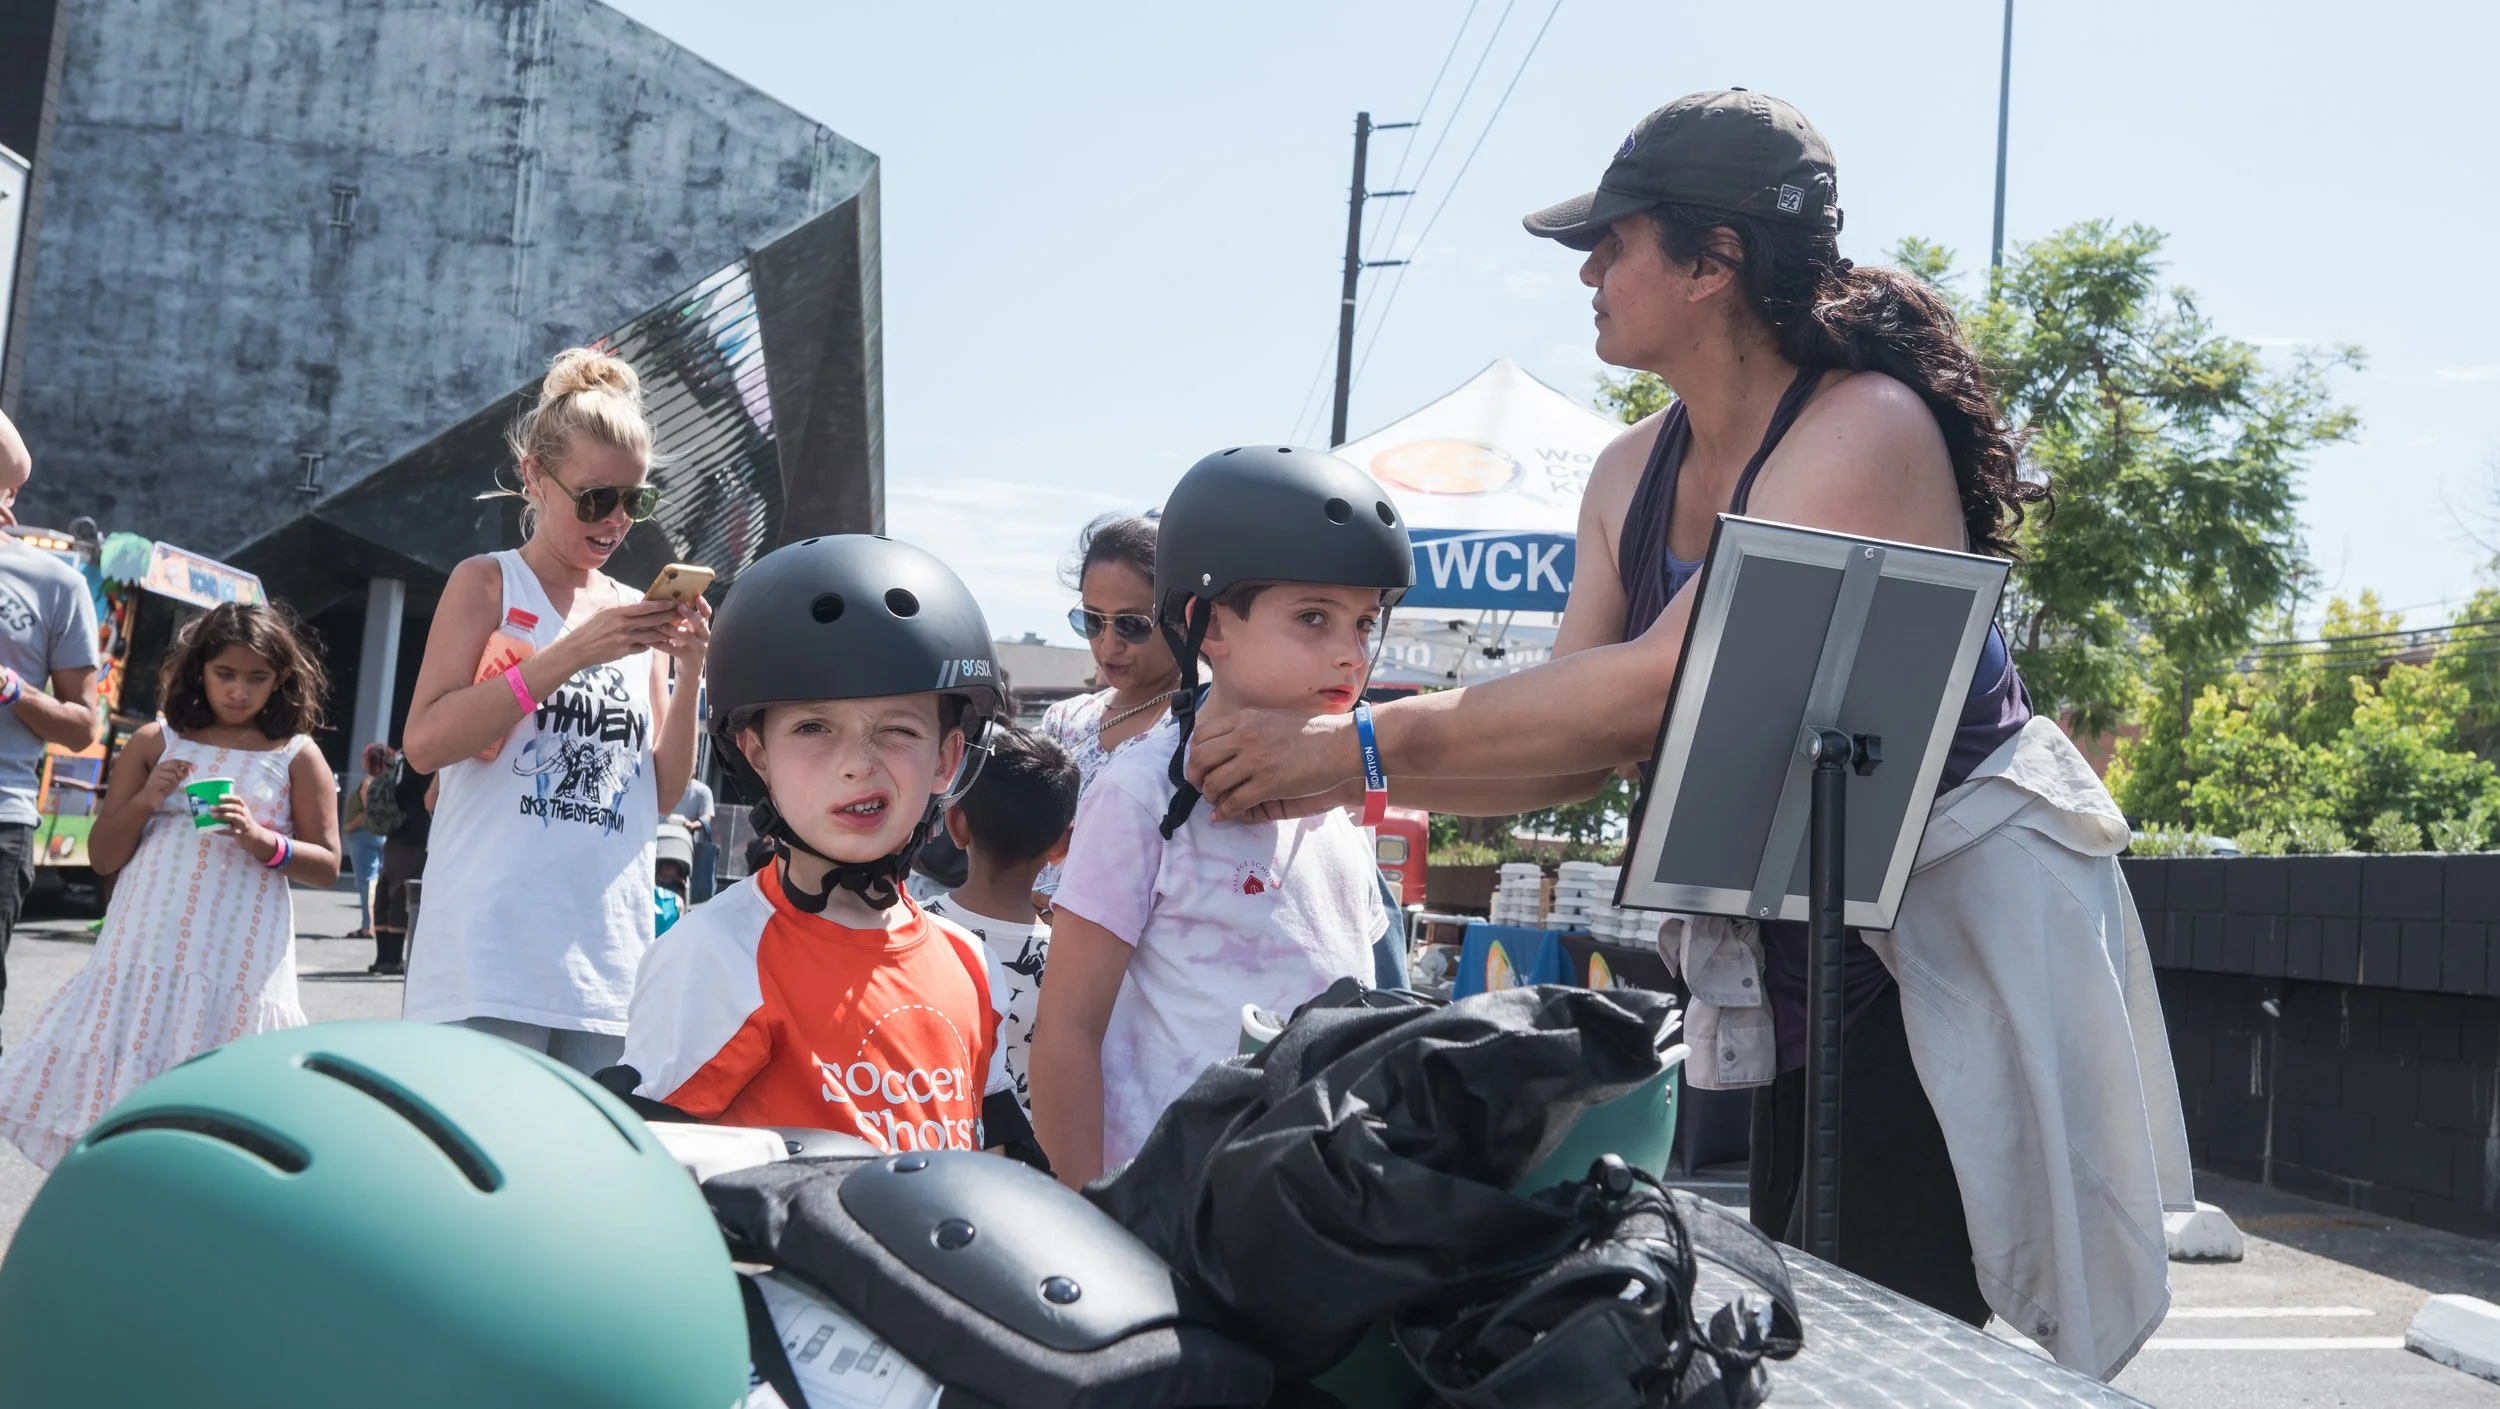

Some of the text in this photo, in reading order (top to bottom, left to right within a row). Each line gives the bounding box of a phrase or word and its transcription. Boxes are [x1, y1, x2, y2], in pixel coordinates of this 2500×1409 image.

[535, 690, 645, 752] HAVEN
[520, 794, 548, 817] SK8
[549, 798, 573, 821] THE
